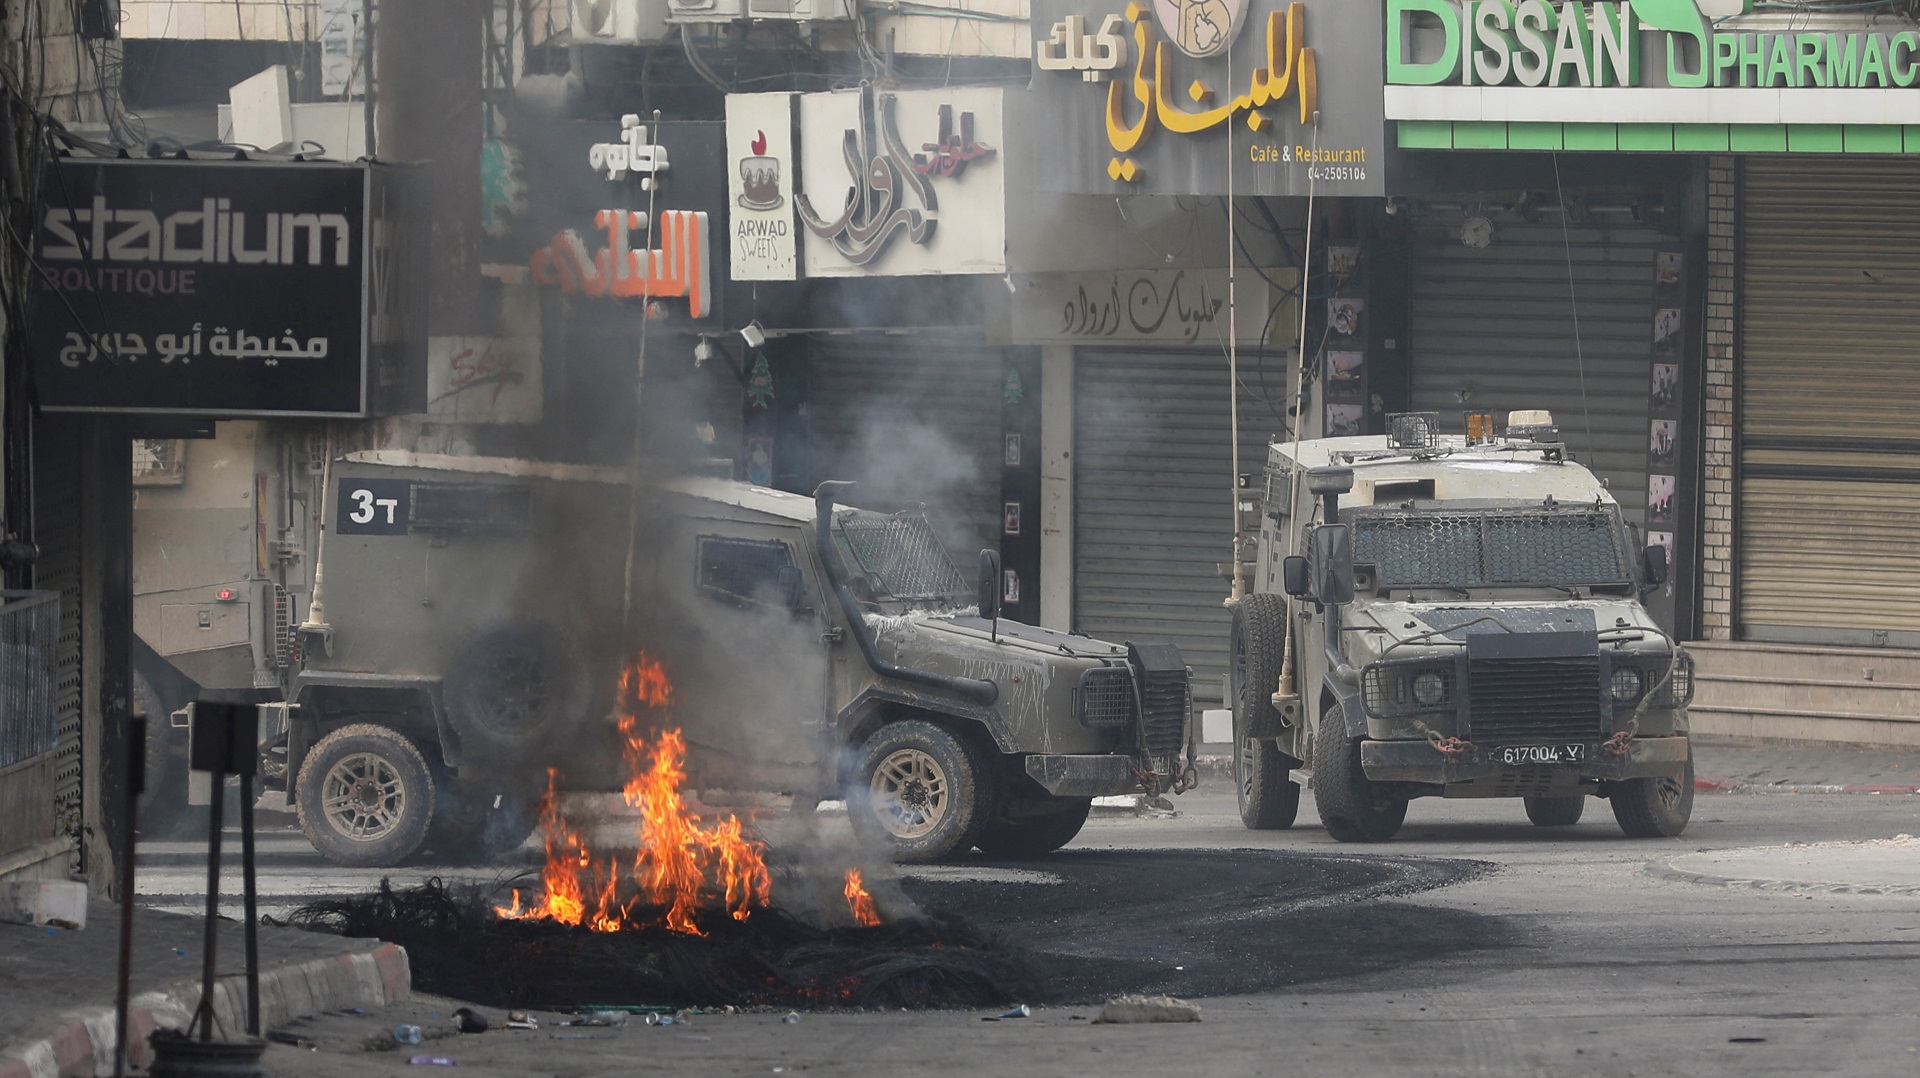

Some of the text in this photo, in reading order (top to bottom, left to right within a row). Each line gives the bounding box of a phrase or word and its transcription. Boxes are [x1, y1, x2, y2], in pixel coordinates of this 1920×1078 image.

[1037, 14, 1126, 82] كيك
[1386, 0, 1920, 88] DISSAN PHARMAC
[1106, 1, 1316, 181] اللبناني
[1250, 144, 1366, 162] Café & Restaurant
[1308, 166, 1366, 181] 04-2505106
[43, 195, 349, 266] stadium
[737, 219, 787, 236] ARWAD
[739, 234, 778, 261] SWEETS
[42, 267, 196, 297] BOUTIQUE
[59, 322, 329, 369] مخيطة أبو جورج
